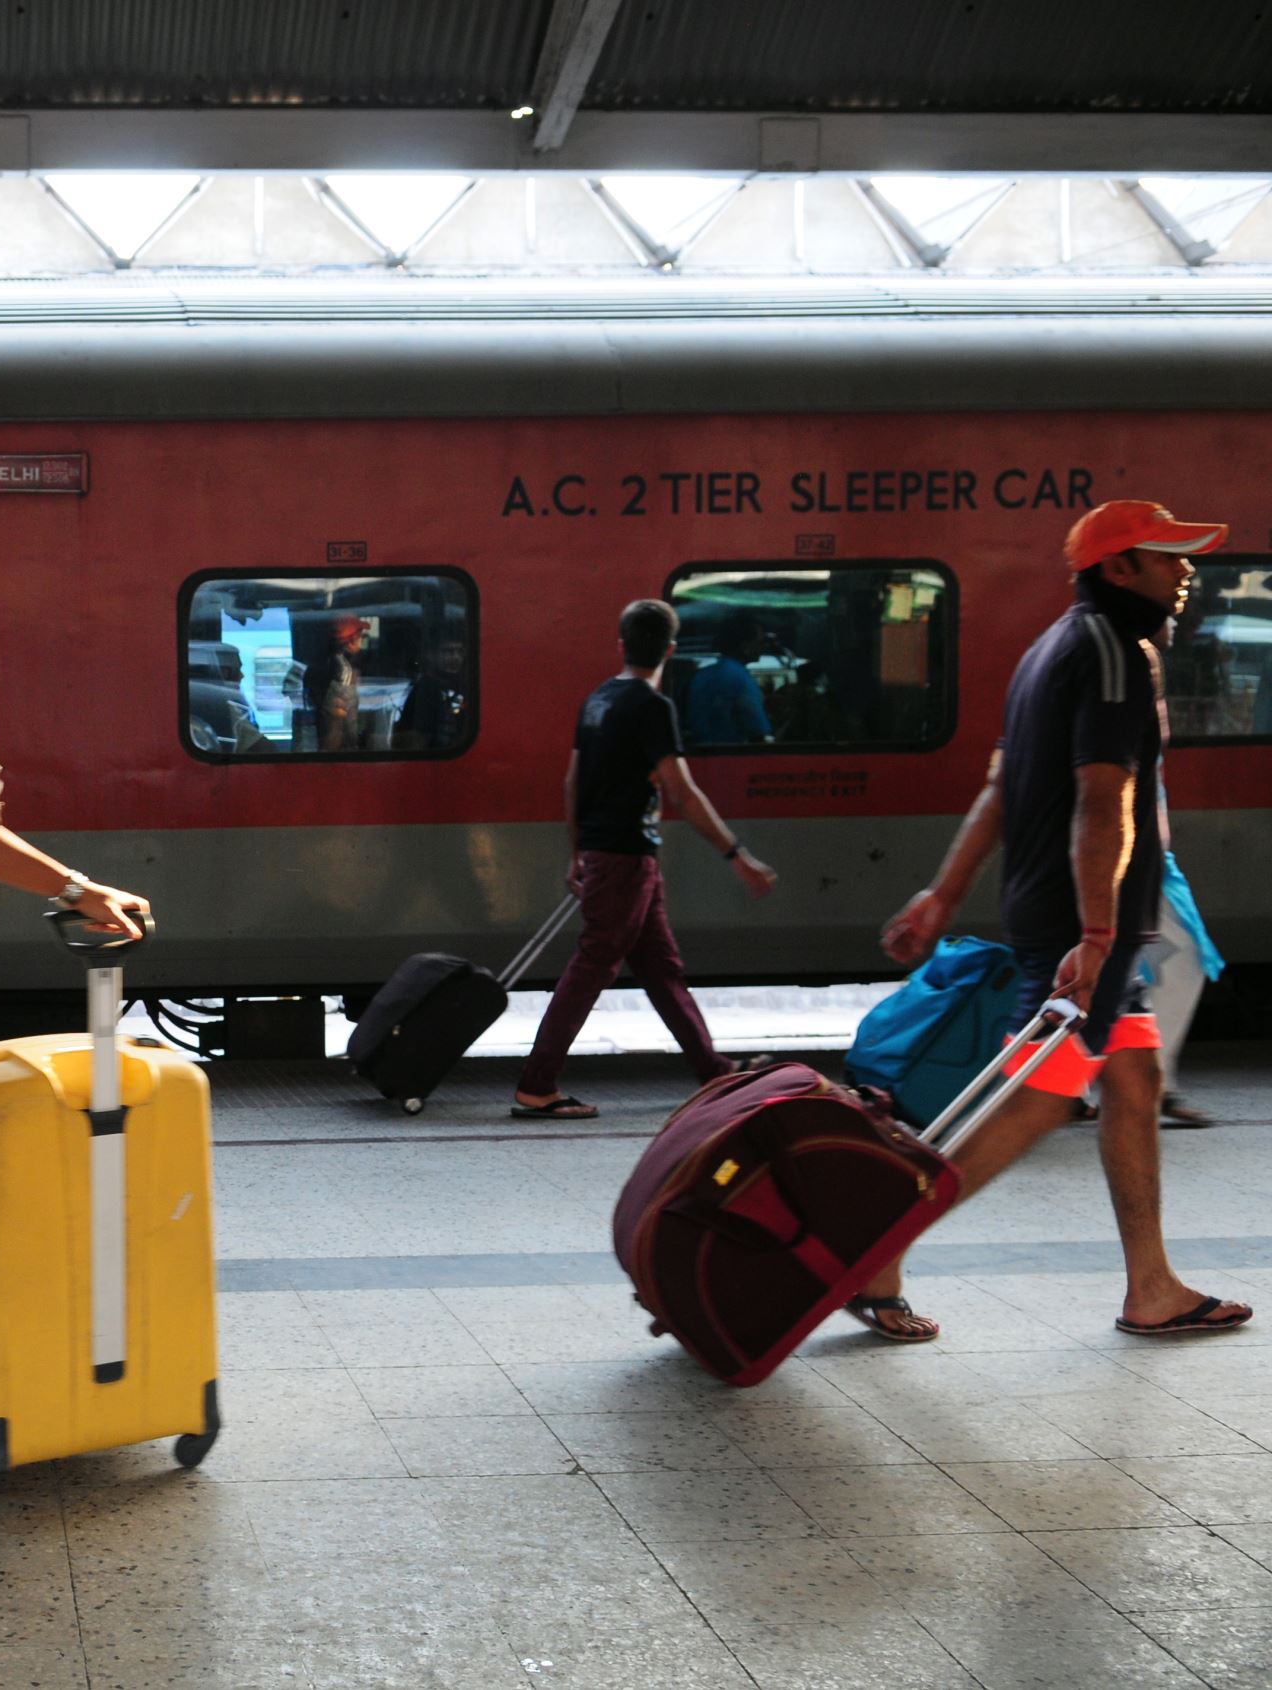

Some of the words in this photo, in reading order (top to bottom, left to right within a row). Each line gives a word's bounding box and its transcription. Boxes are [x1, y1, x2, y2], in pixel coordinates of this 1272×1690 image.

[501, 475, 597, 516] A.C.
[620, 475, 647, 516] 2
[660, 472, 763, 514] TIER
[790, 470, 979, 513] SLEEPER
[994, 468, 1094, 509] CAR
